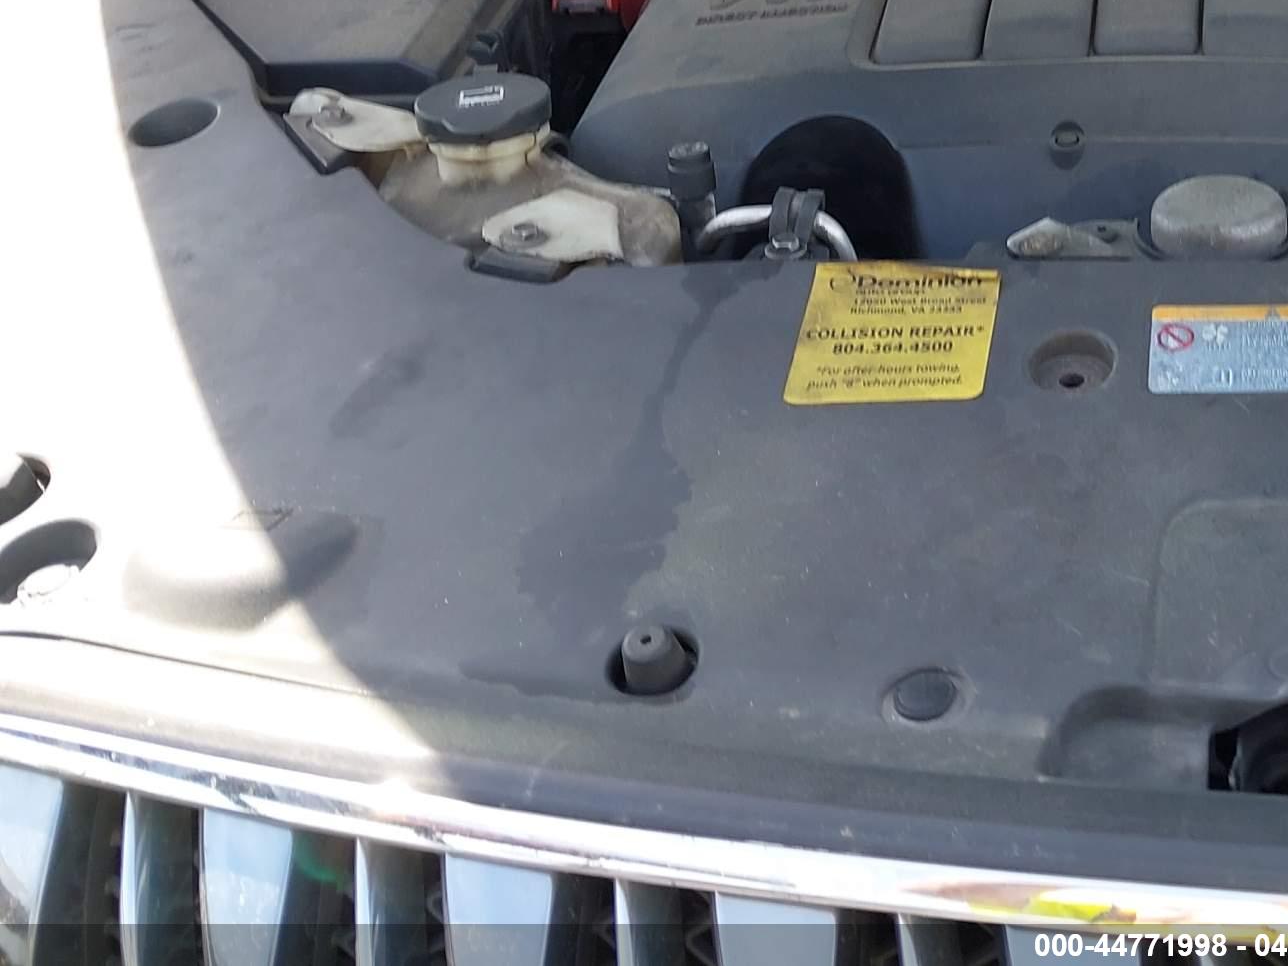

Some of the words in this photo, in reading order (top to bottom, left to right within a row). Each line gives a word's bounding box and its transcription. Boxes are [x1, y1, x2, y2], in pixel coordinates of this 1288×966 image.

[857, 274, 983, 288] Dominion
[911, 306, 925, 314] VA
[806, 325, 903, 340] COLLISION
[832, 341, 954, 355] 804.364.4500
[862, 376, 896, 389] when
